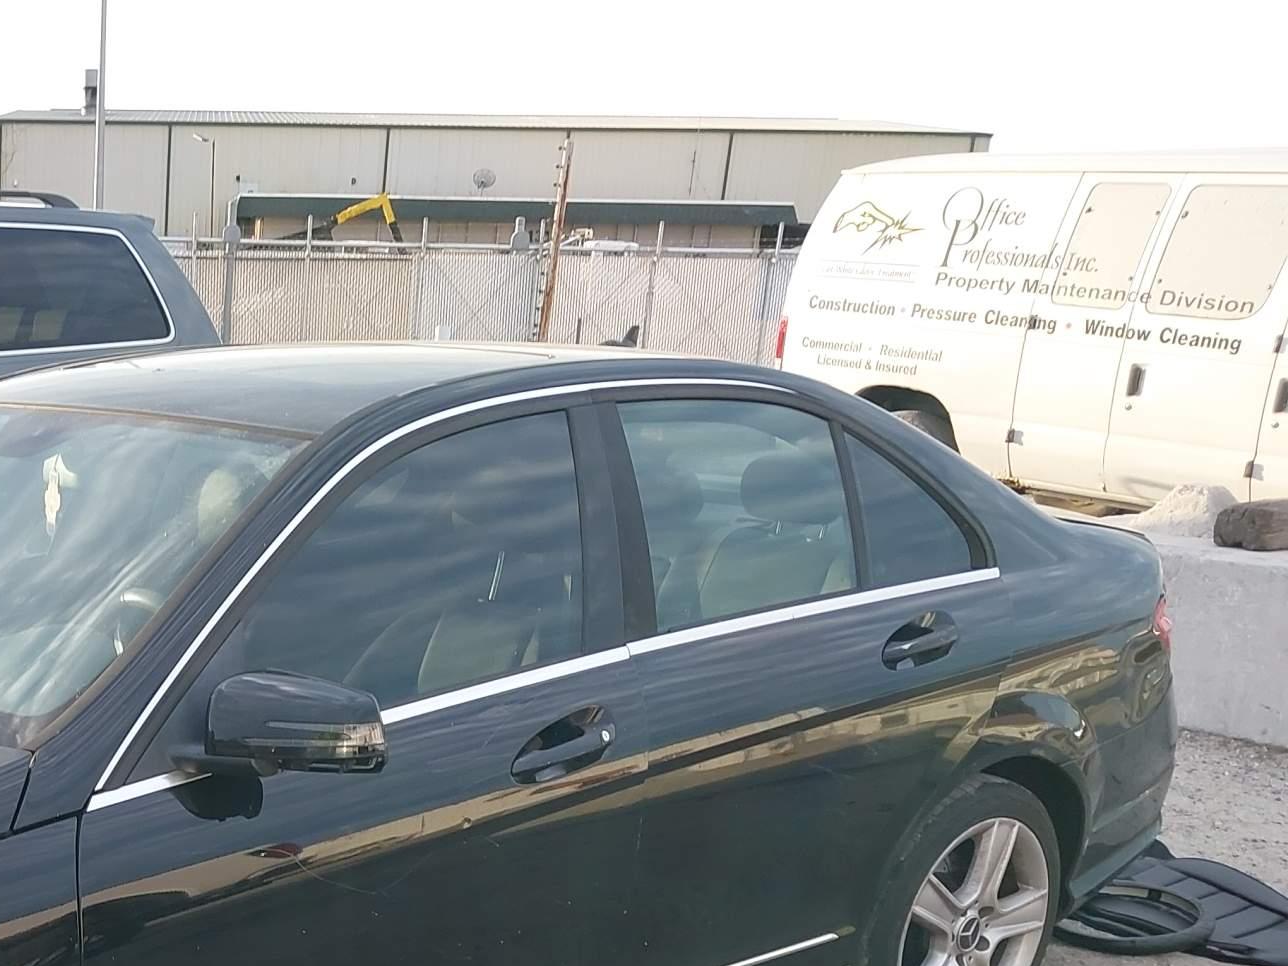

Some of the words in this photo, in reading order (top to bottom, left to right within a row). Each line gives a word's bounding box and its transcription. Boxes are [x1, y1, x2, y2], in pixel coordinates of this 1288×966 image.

[942, 186, 1027, 232] Office
[939, 218, 1063, 272] Professionals
[1065, 252, 1100, 273] Inc.
[934, 271, 1016, 296] Property
[1159, 290, 1256, 314] Division
[808, 295, 896, 317] Construction
[910, 303, 978, 324] Pressure
[984, 309, 1058, 335] Cleaning
[1084, 318, 1152, 342] Window
[1159, 326, 1243, 356] Cleaning
[802, 336, 863, 353] Commercial
[879, 344, 944, 363] Residential
[816, 354, 863, 370] Licensed
[864, 359, 873, 371] &
[875, 359, 919, 376] Insured
